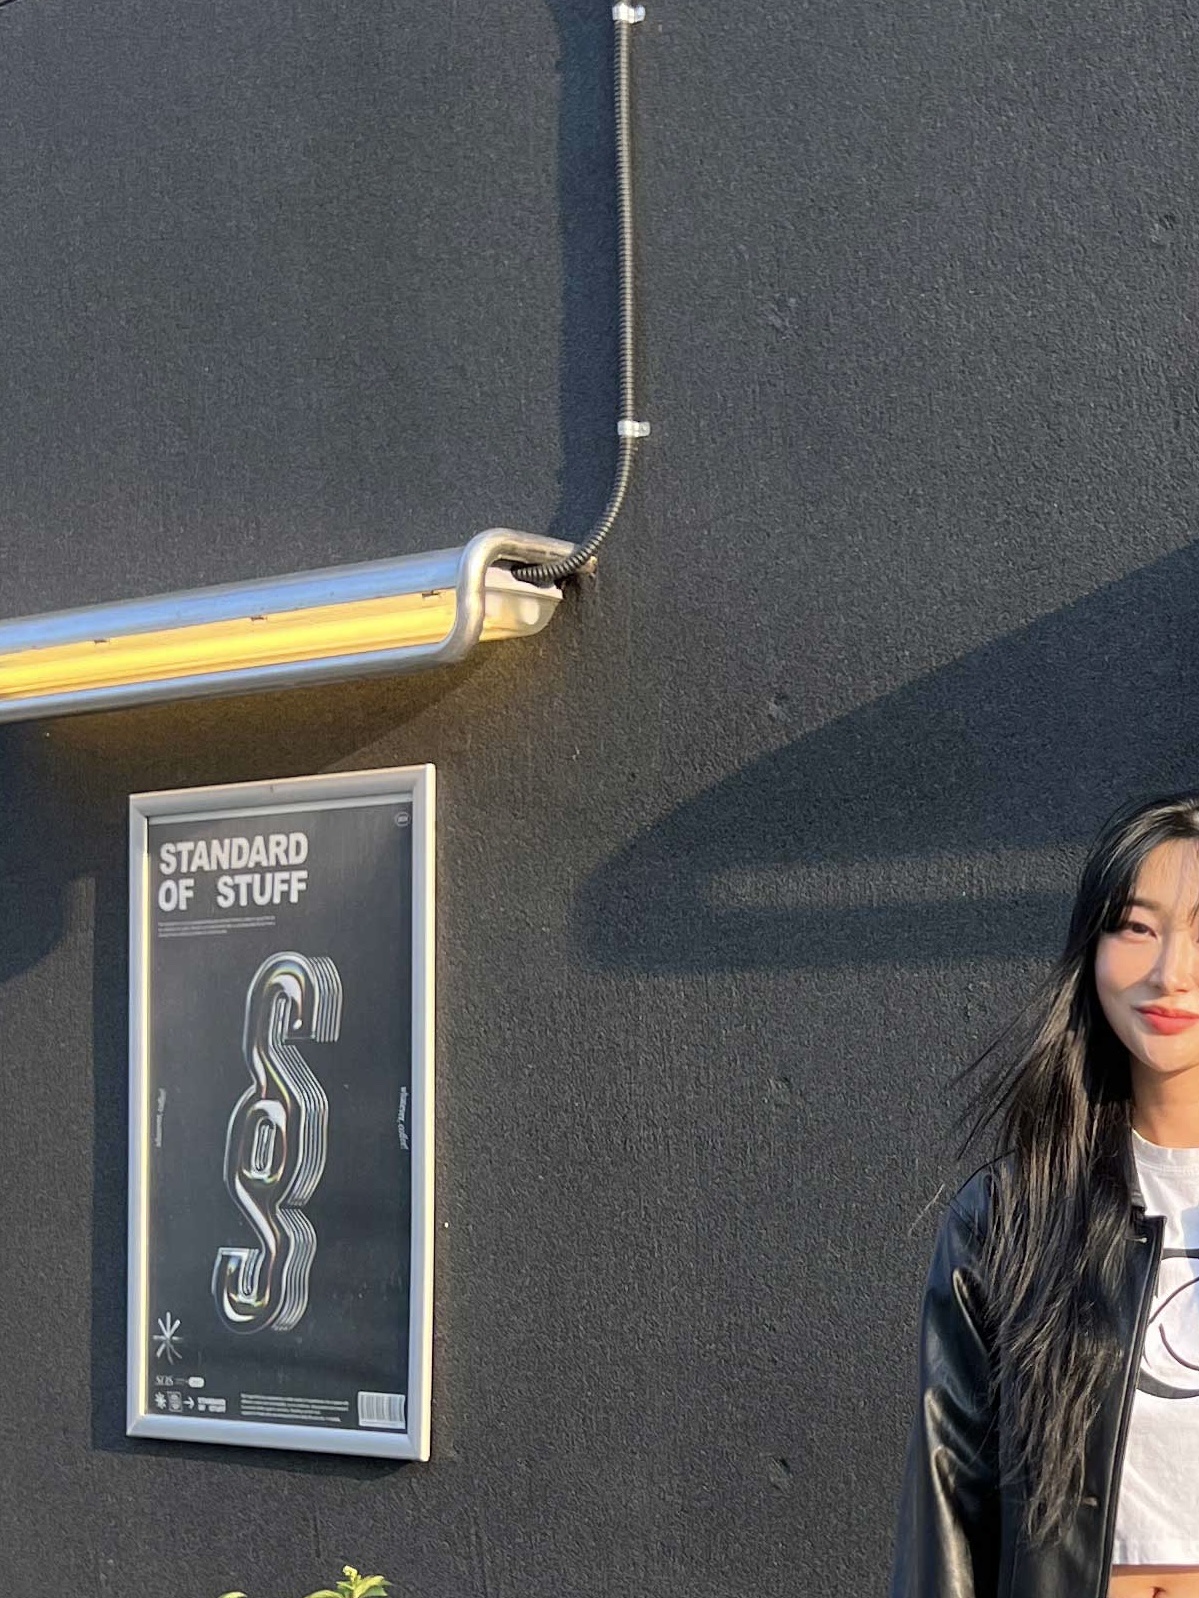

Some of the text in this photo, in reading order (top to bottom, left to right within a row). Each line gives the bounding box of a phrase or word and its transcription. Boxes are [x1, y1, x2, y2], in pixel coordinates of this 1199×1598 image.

[159, 832, 309, 875] STANDARD
[158, 870, 309, 912] OF STUFF
